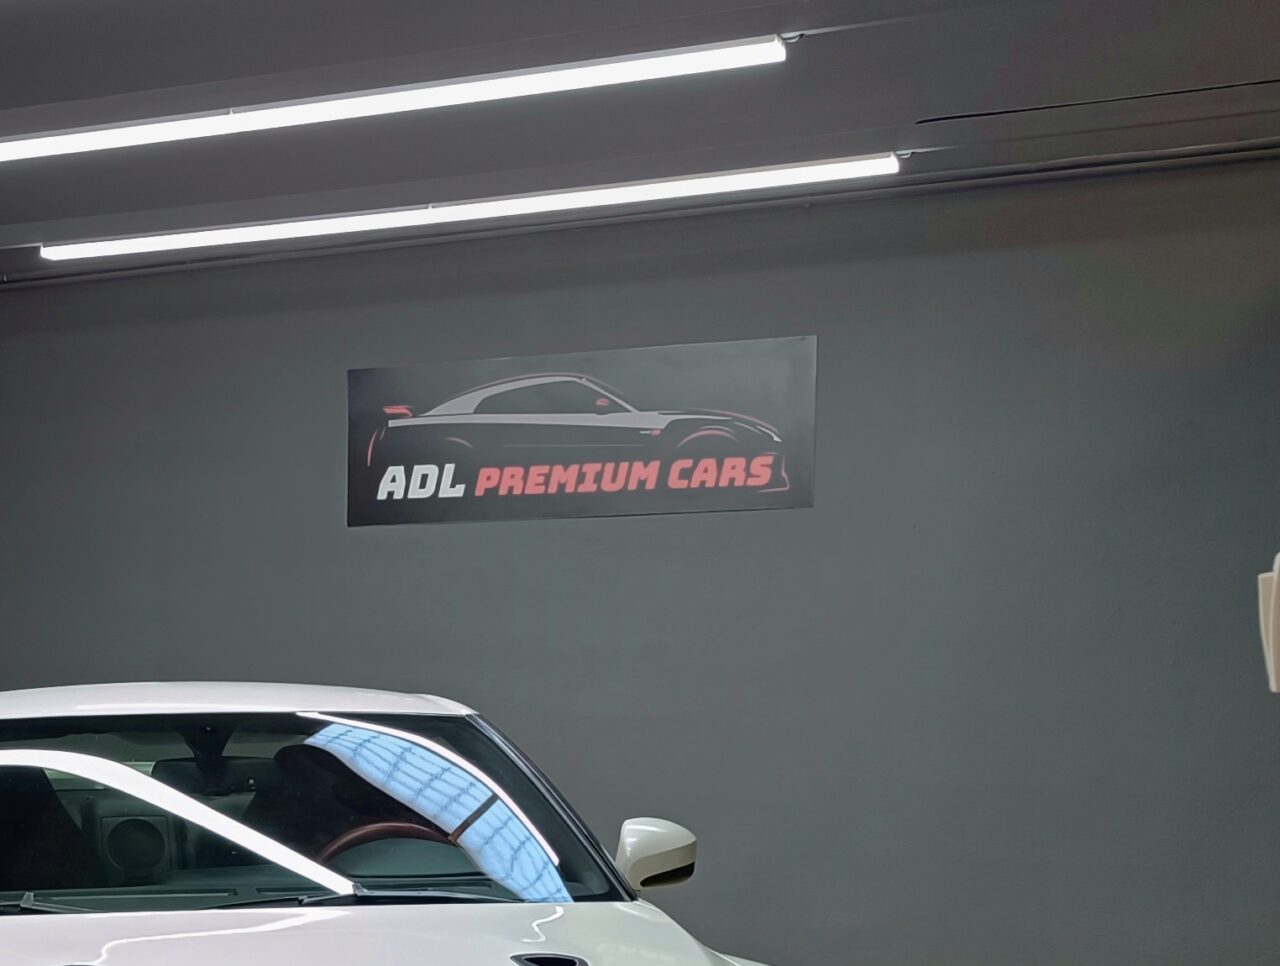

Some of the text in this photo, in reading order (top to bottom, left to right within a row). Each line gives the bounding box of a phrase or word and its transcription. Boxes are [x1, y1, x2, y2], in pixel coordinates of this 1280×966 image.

[376, 456, 773, 500] ADL PREMIUM CARS
